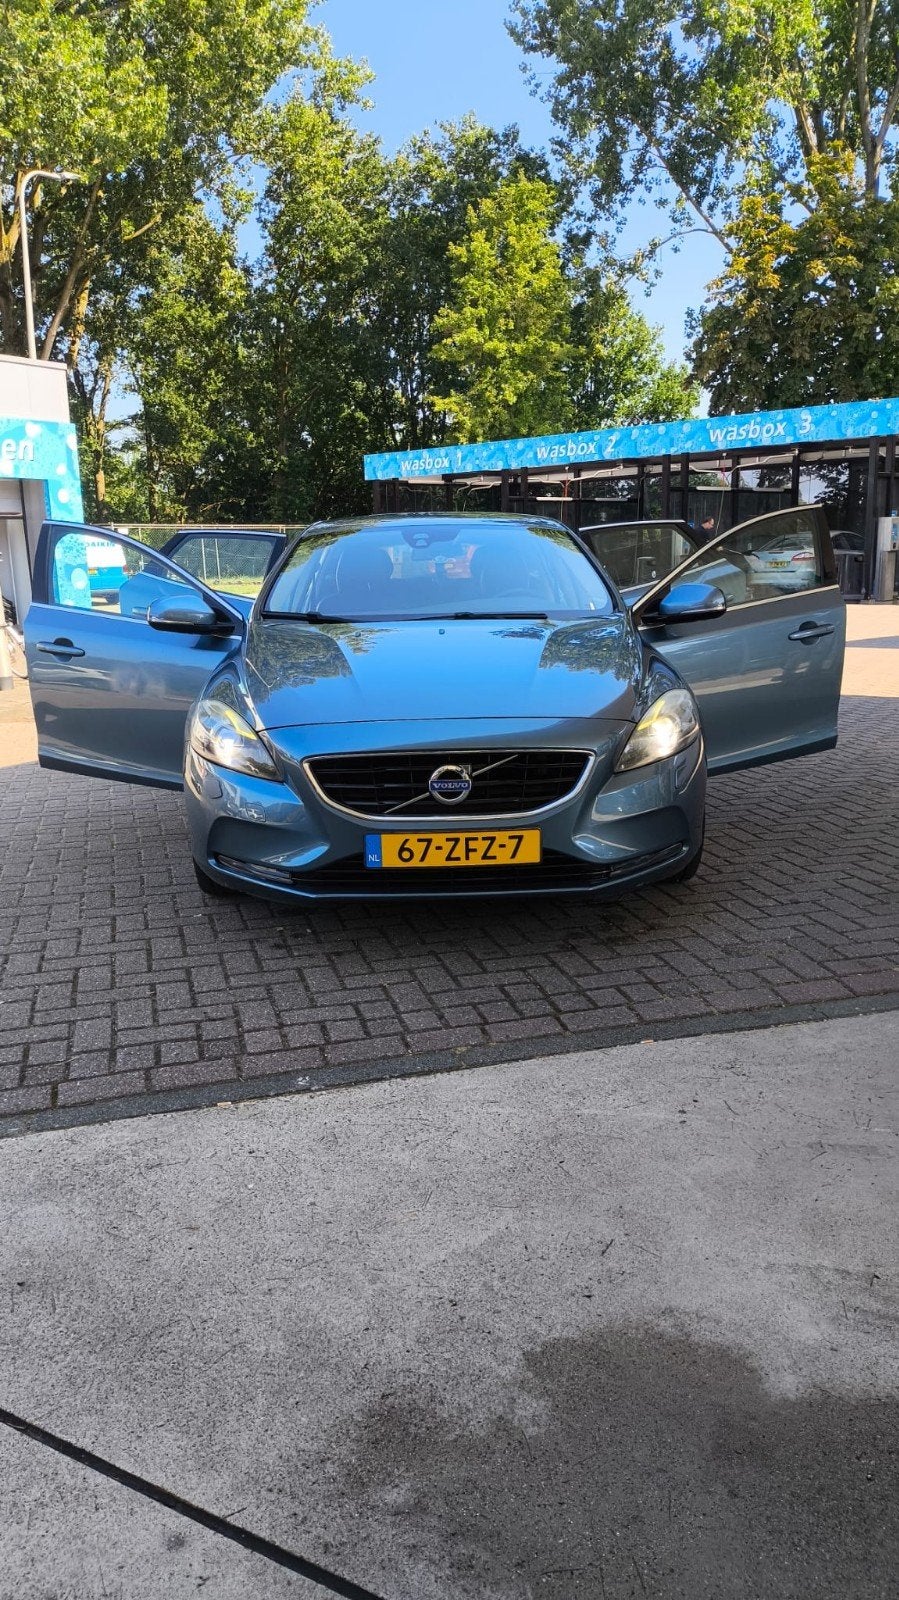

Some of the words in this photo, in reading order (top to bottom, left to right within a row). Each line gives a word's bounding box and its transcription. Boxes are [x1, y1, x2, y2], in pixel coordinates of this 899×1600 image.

[709, 419, 787, 442] wasbox
[799, 413, 812, 434] 3
[1, 438, 35, 462] en
[536, 439, 598, 459] wasbox
[605, 435, 617, 453] 2
[401, 453, 450, 471] wasbox
[456, 451, 463, 466] 1
[432, 781, 469, 789] VOLVO
[368, 854, 380, 862] NL
[397, 834, 524, 863] 67-ZFZ-7
